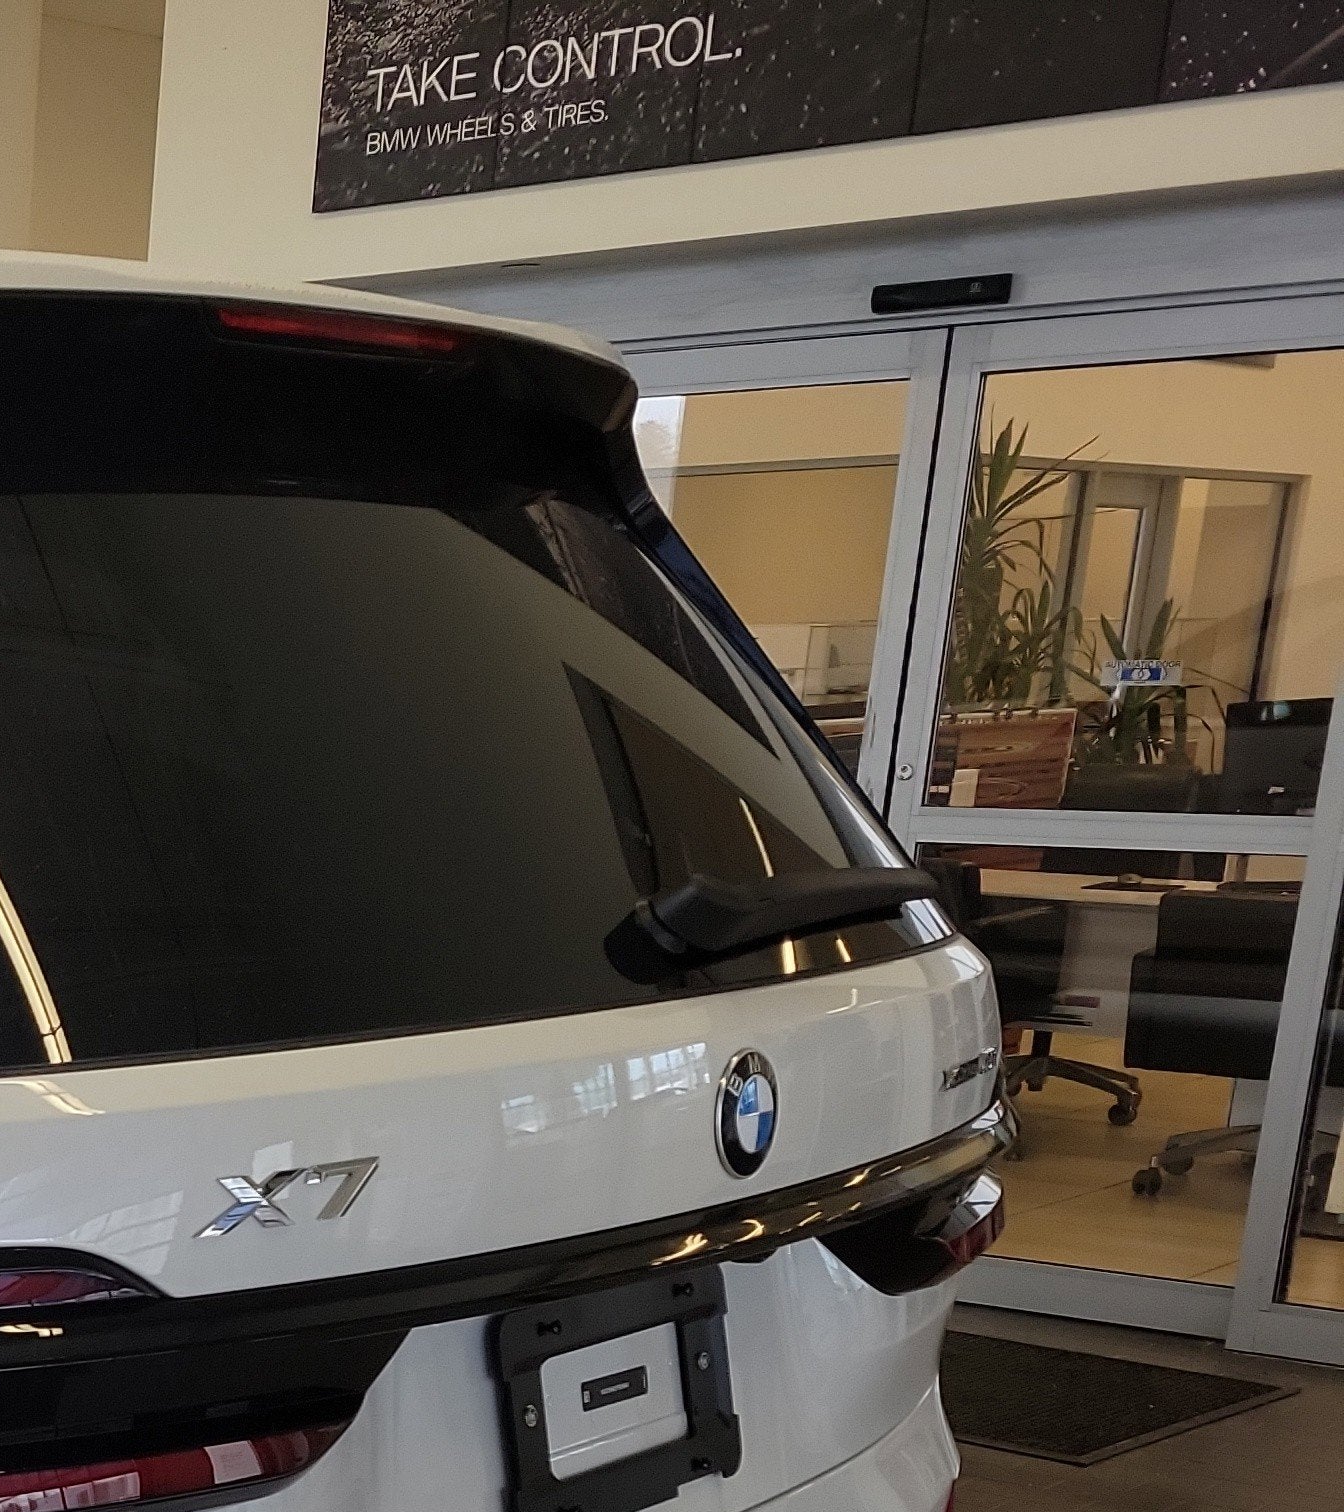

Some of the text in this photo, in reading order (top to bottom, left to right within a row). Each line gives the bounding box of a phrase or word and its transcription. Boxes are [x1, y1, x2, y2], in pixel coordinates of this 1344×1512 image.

[366, 12, 743, 113] TAKE CONTROL.
[365, 99, 609, 156] BMW WHEELS & TIRES.
[191, 1155, 381, 1240] X7
